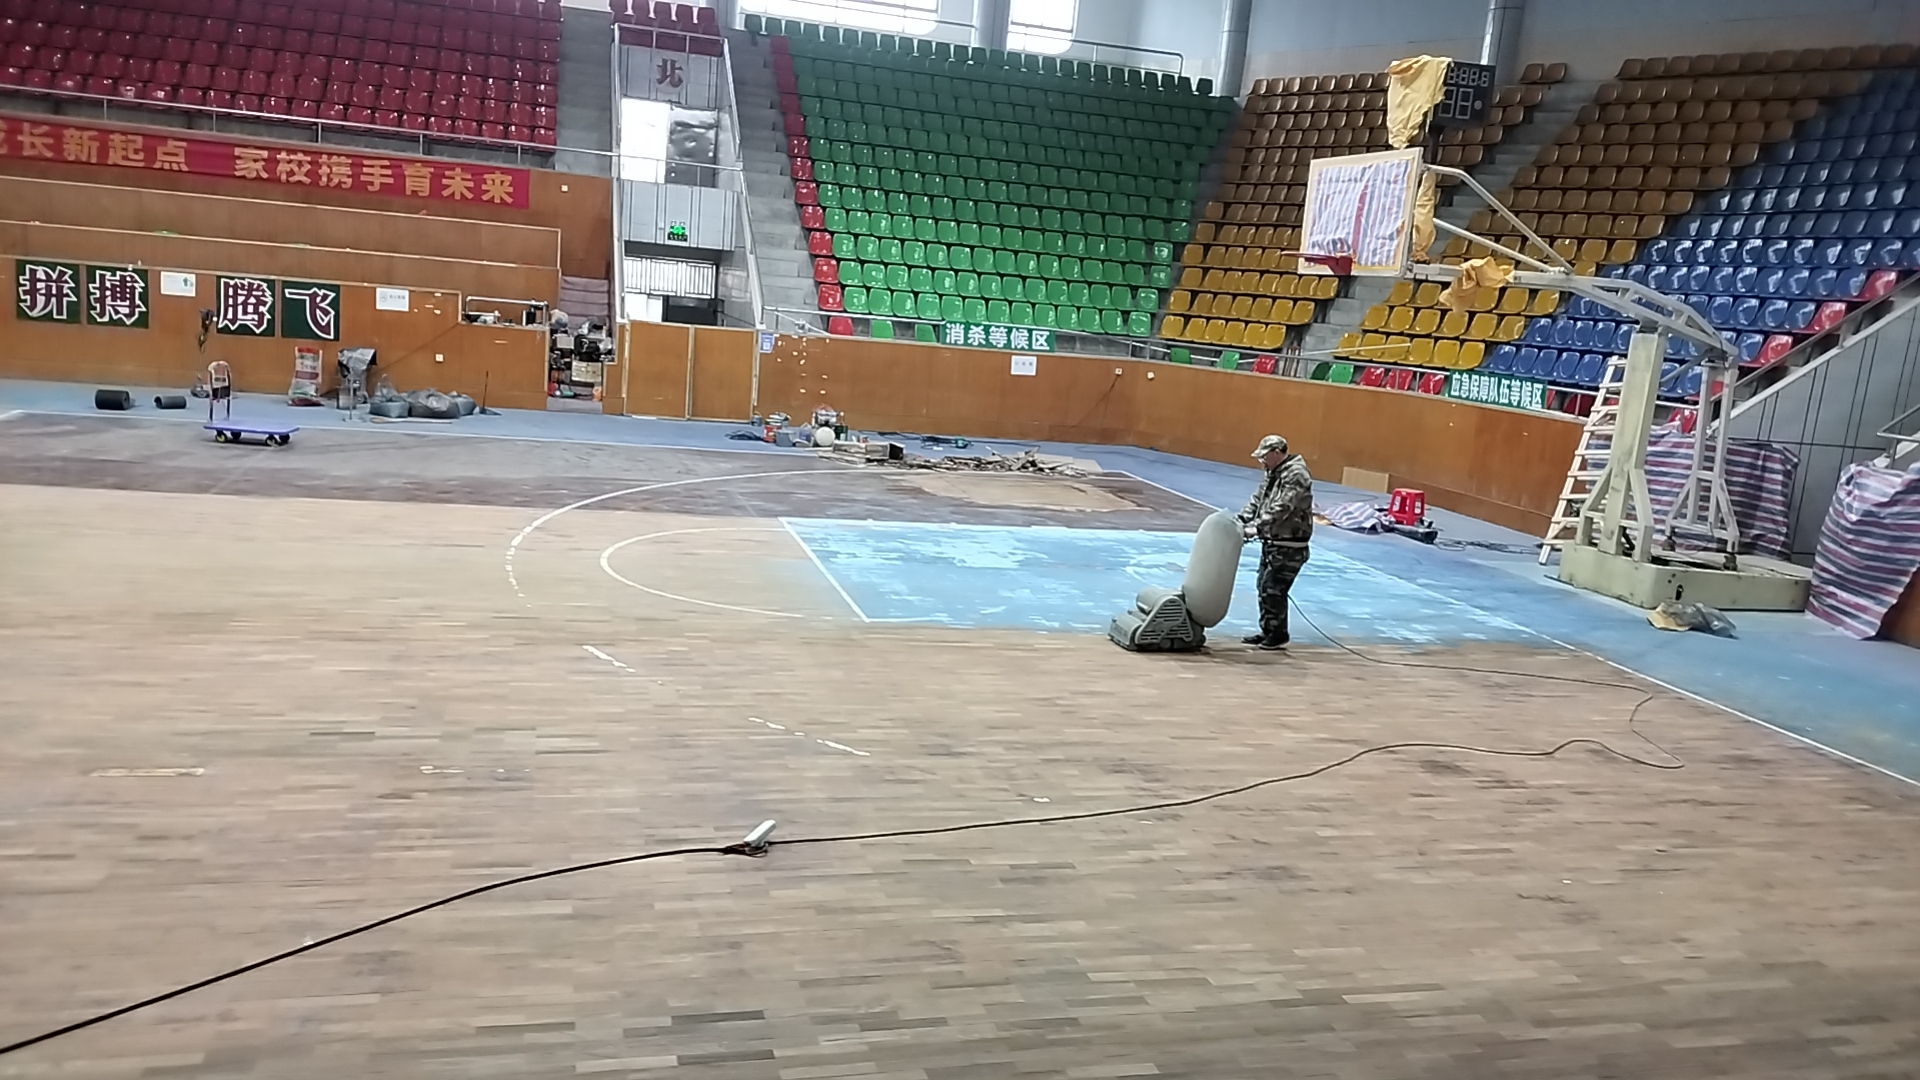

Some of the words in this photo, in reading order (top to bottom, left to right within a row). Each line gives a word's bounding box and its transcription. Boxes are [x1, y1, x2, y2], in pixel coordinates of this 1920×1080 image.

[656, 58, 684, 88] 北
[234, 146, 514, 204] 家校携手育未来
[945, 322, 1050, 351] 消杀等候区
[1450, 372, 1544, 410] 应急保障队伍等候区
